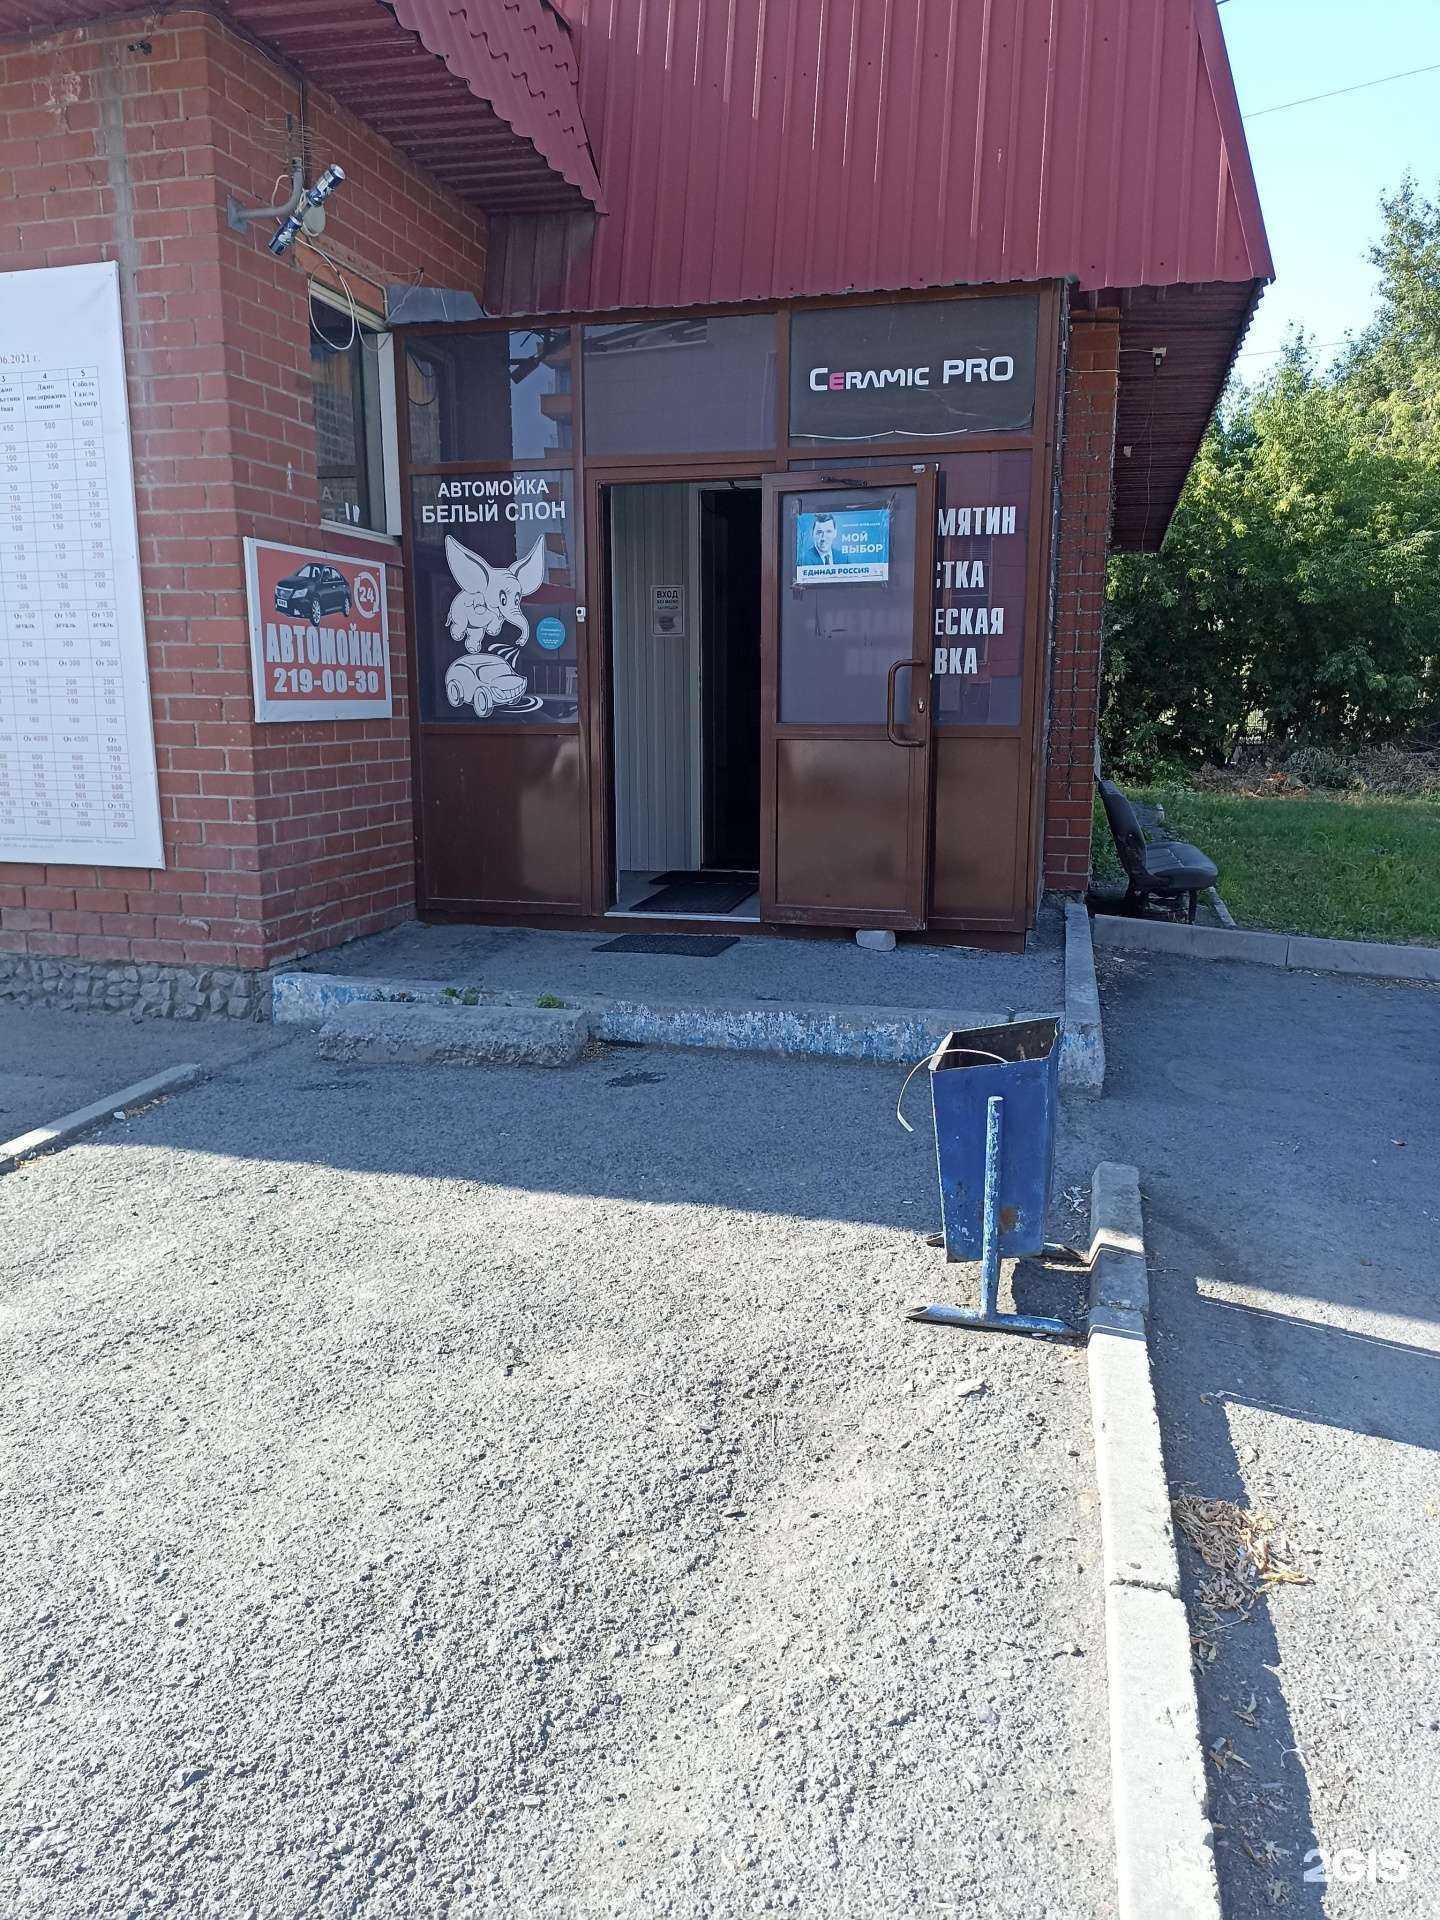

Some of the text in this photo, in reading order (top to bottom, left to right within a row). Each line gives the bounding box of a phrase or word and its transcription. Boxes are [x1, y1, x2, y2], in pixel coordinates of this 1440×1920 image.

[809, 356, 1014, 392] CERAMIC PRO
[437, 475, 550, 498] АВТОМОЙКА
[422, 499, 566, 524] БЕЛЫЙ СЛОН
[937, 506, 1016, 536] МЯТИН
[841, 531, 868, 542] МОЙ
[841, 544, 883, 554] ВЫБОР
[803, 567, 870, 577] ЕДИНАЯ РОССИЯ
[359, 587, 375, 603] 24
[656, 590, 679, 599] ВХОД
[934, 607, 1005, 636] ЕСКАЯ
[266, 623, 384, 667] АВТОМОЙКА
[934, 647, 978, 675] ВКА
[274, 668, 379, 694] 219-00-30
